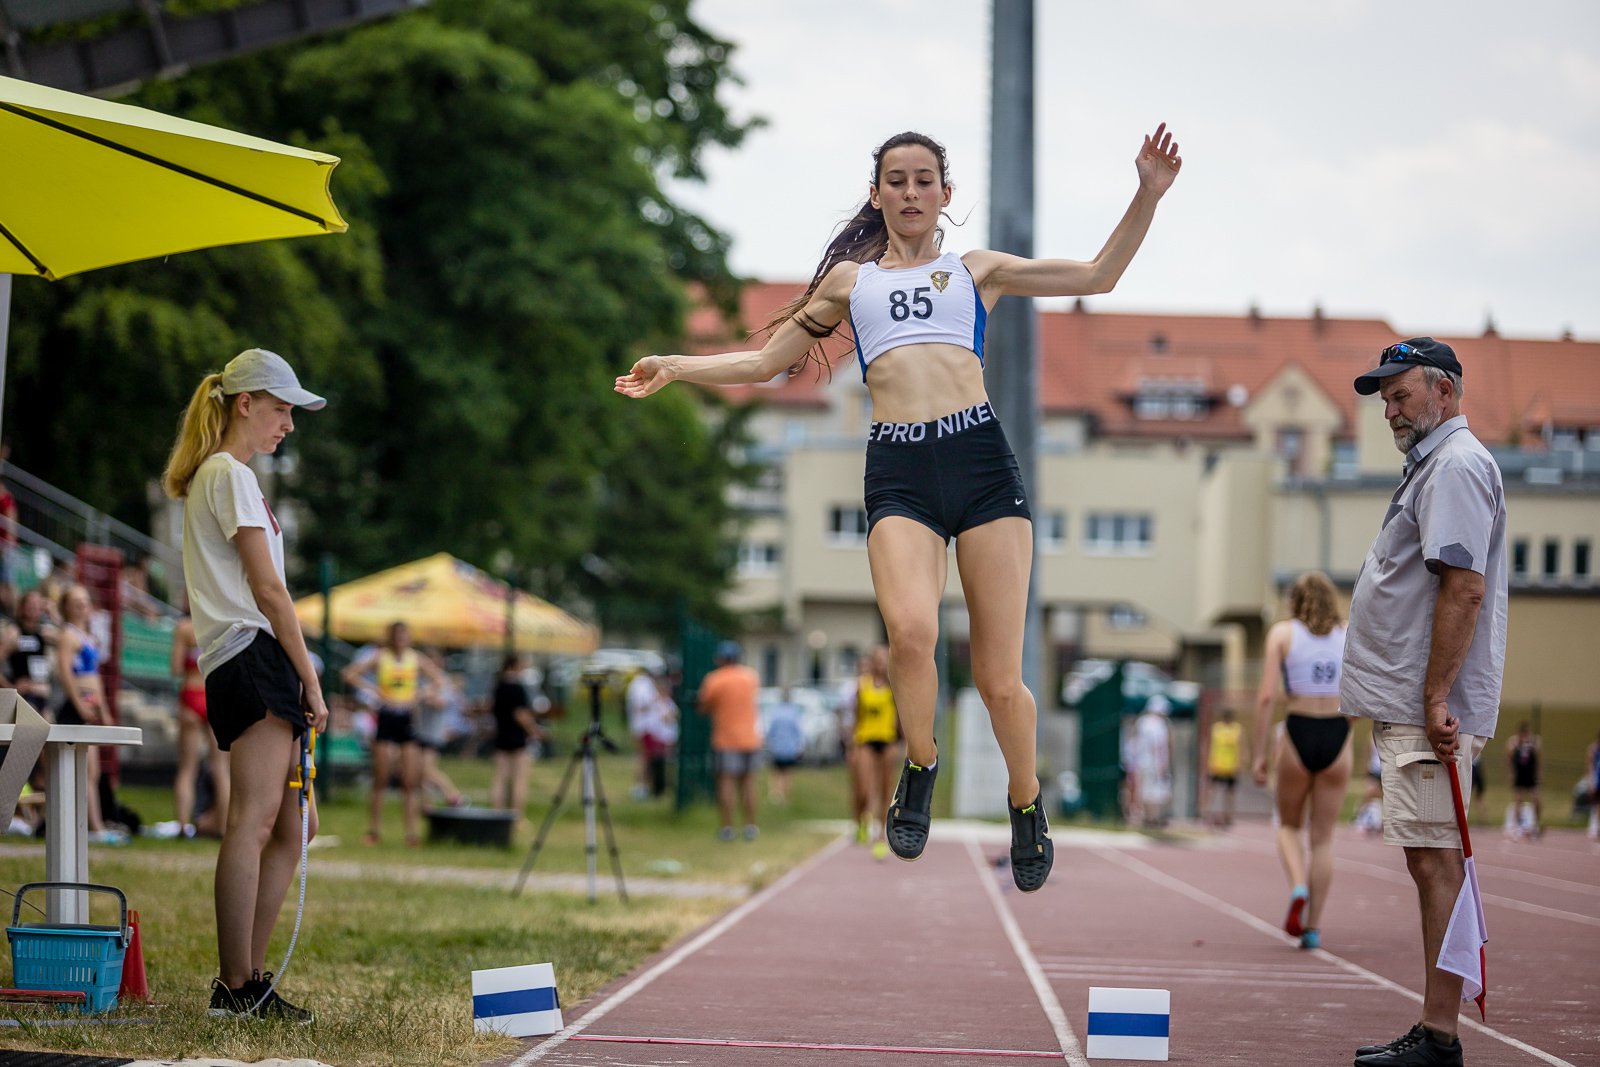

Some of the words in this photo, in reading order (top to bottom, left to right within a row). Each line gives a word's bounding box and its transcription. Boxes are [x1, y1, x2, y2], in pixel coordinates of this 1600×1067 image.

[889, 286, 933, 322] 85
[877, 421, 926, 442] PRO
[937, 402, 991, 439] NIKE
